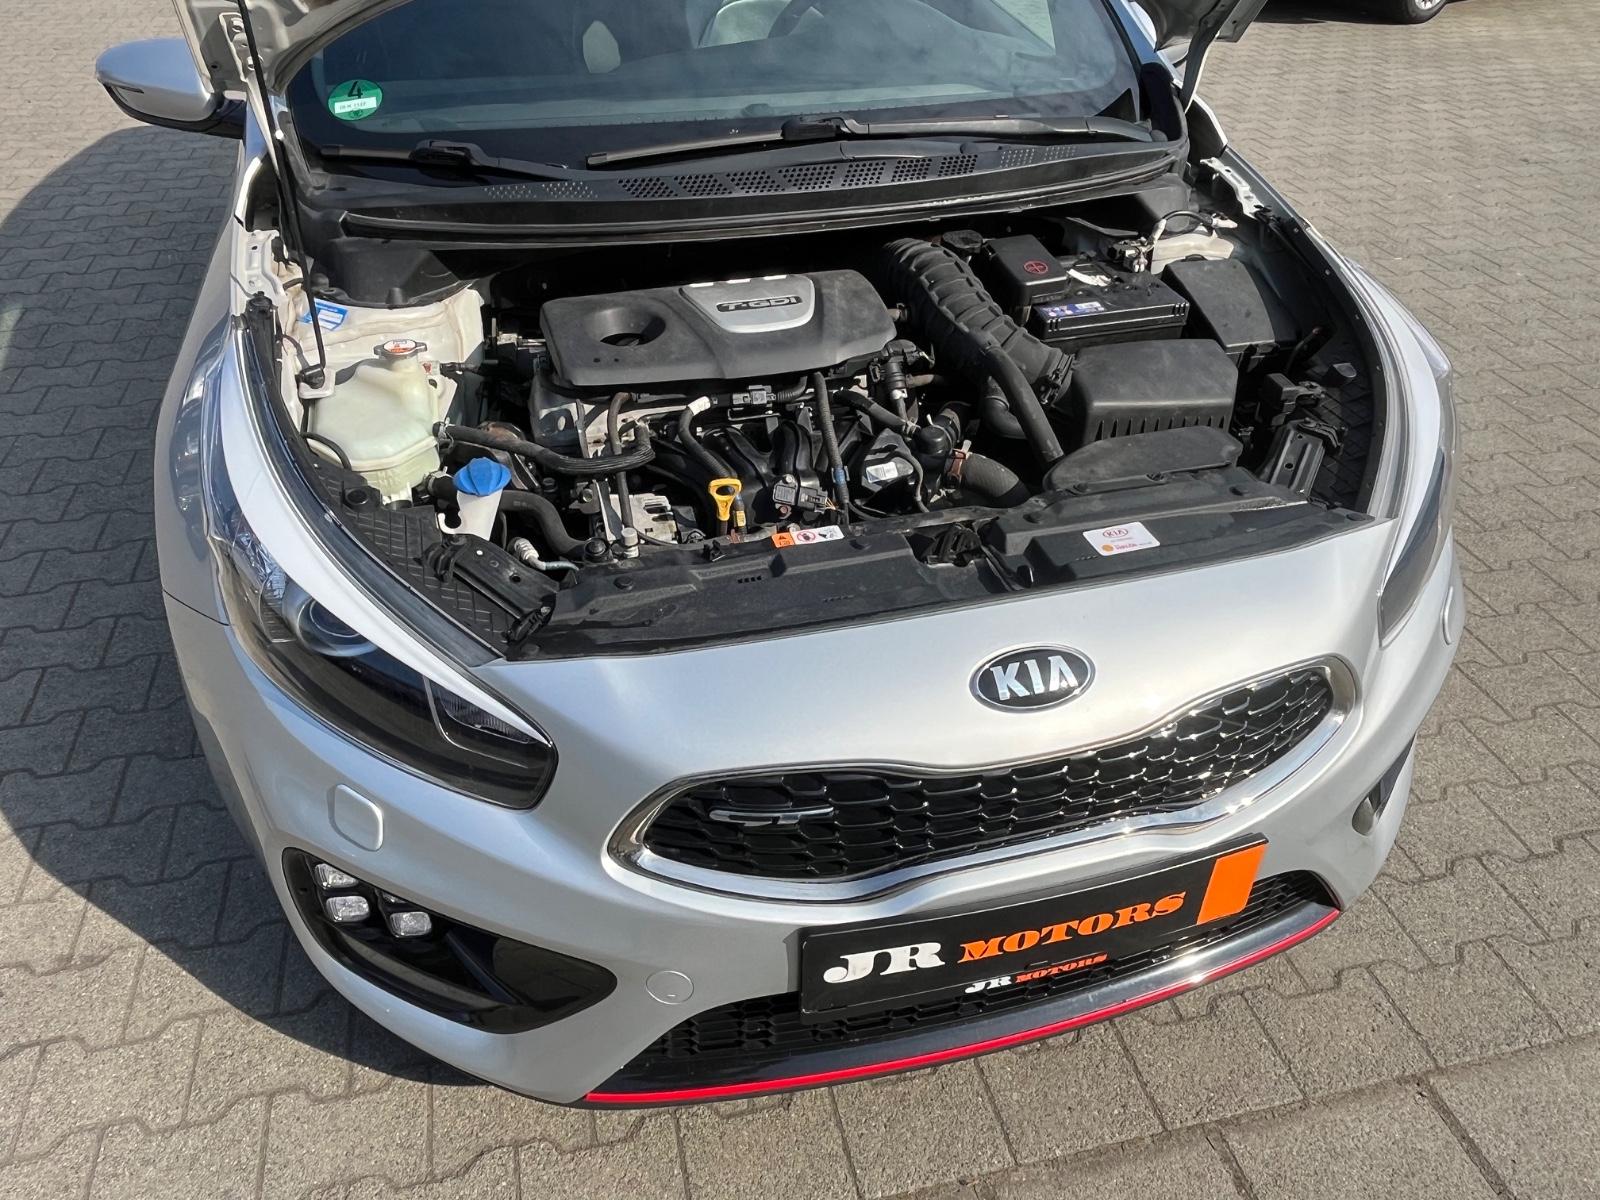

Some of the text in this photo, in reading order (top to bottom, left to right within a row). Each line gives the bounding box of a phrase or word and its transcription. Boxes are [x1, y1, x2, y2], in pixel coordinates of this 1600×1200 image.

[347, 80, 363, 99] 4
[989, 655, 1079, 701] KIA
[823, 891, 1188, 984] JR MOTORS
[964, 953, 1109, 994] JR MOTORS
